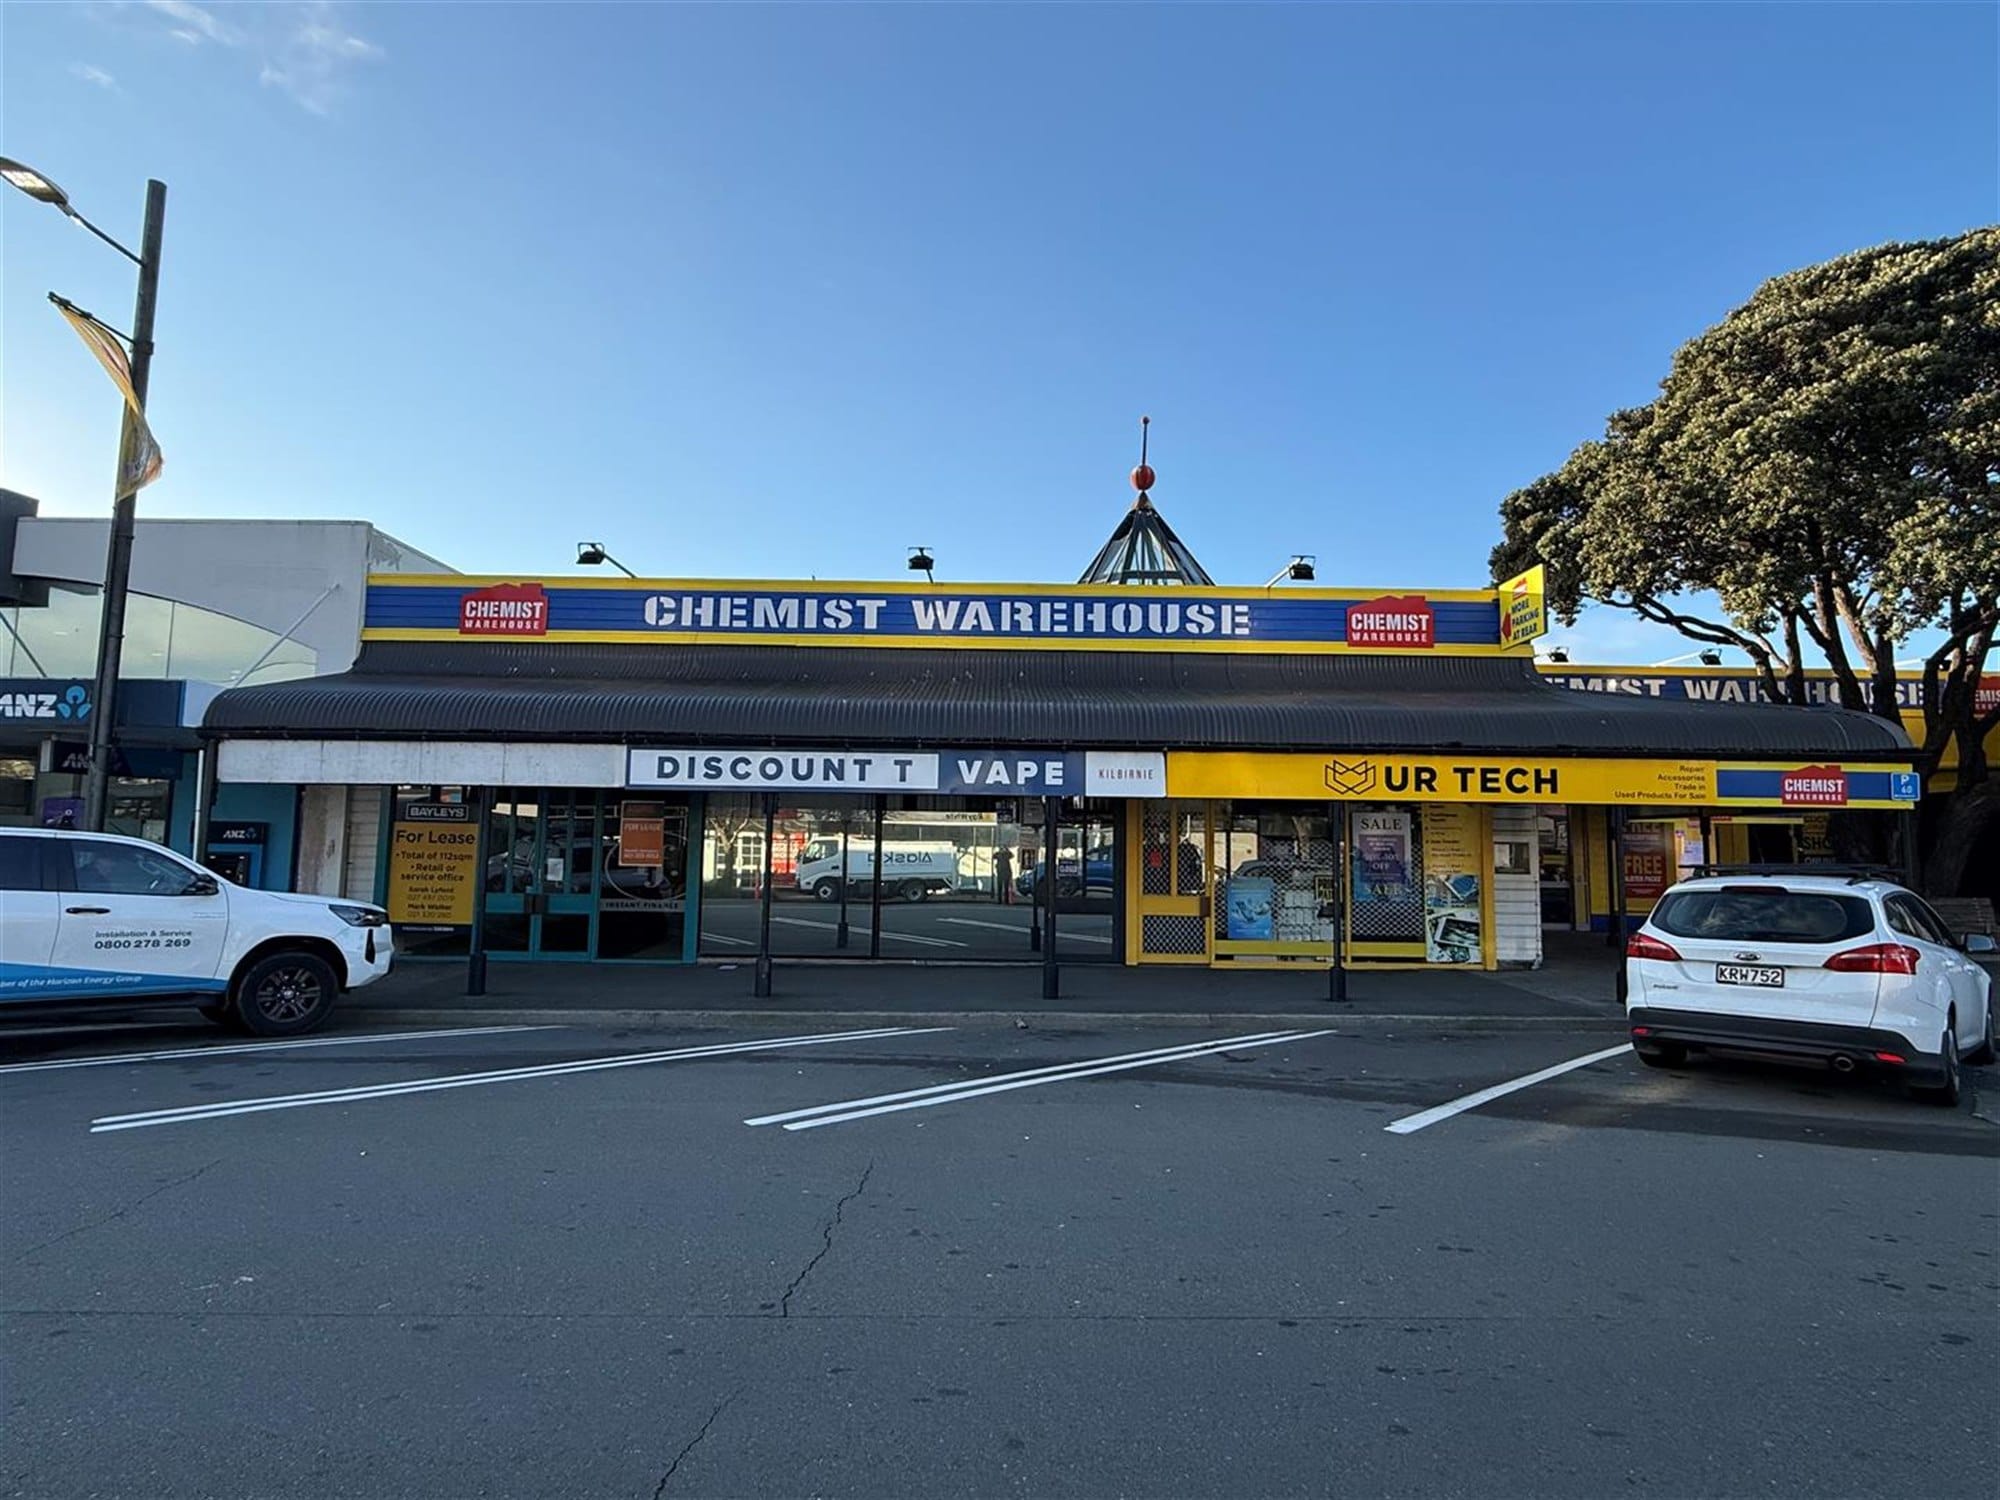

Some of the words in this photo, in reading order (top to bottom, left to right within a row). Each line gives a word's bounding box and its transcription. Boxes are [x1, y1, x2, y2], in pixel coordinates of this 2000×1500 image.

[465, 600, 544, 619] CHEMIST
[1511, 598, 1529, 614] MORE
[644, 596, 887, 630] CHEMIST
[912, 600, 1250, 634] WAREHOUSE
[1512, 607, 1539, 626] PARKING
[464, 619, 540, 629] WAREHOUSE
[1351, 612, 1429, 631] CHEMIST
[1352, 632, 1428, 642] WAREHOUSE
[1512, 628, 1520, 641] AT
[1521, 622, 1537, 639] REAR
[656, 756, 872, 782] DISCOUNT
[893, 759, 913, 782] T
[957, 760, 1064, 785] VAPE
[1098, 768, 1154, 780] KILBIRNIE
[1679, 765, 1705, 773] Repair
[1384, 766, 1437, 792] UR
[1453, 767, 1558, 794] TECH
[1784, 779, 1844, 792] CHEMIST
[1901, 774, 1910, 785] P
[1637, 791, 1672, 799] Products
[1785, 793, 1843, 801] WAREHOUSE
[409, 807, 465, 817] BAYLEYS
[1360, 818, 1403, 830] SALE
[223, 830, 246, 838] ANZ
[395, 830, 424, 843] For
[428, 831, 476, 844] Lease
[401, 851, 425, 859] Total
[426, 851, 437, 860] of
[439, 852, 473, 862] 112sqm
[416, 863, 443, 871] Retail
[1624, 855, 1663, 874] FREE
[400, 873, 435, 881] service
[436, 873, 465, 881] office
[95, 930, 148, 938] Installation
[159, 929, 192, 937] Service
[94, 939, 132, 949] 0800
[133, 939, 161, 948] 278
[164, 938, 191, 948] 269
[1719, 967, 1781, 983] KRW752
[18, 978, 28, 988] of
[30, 978, 45, 986] the
[46, 976, 82, 985] Horizon
[84, 975, 114, 985] Energy
